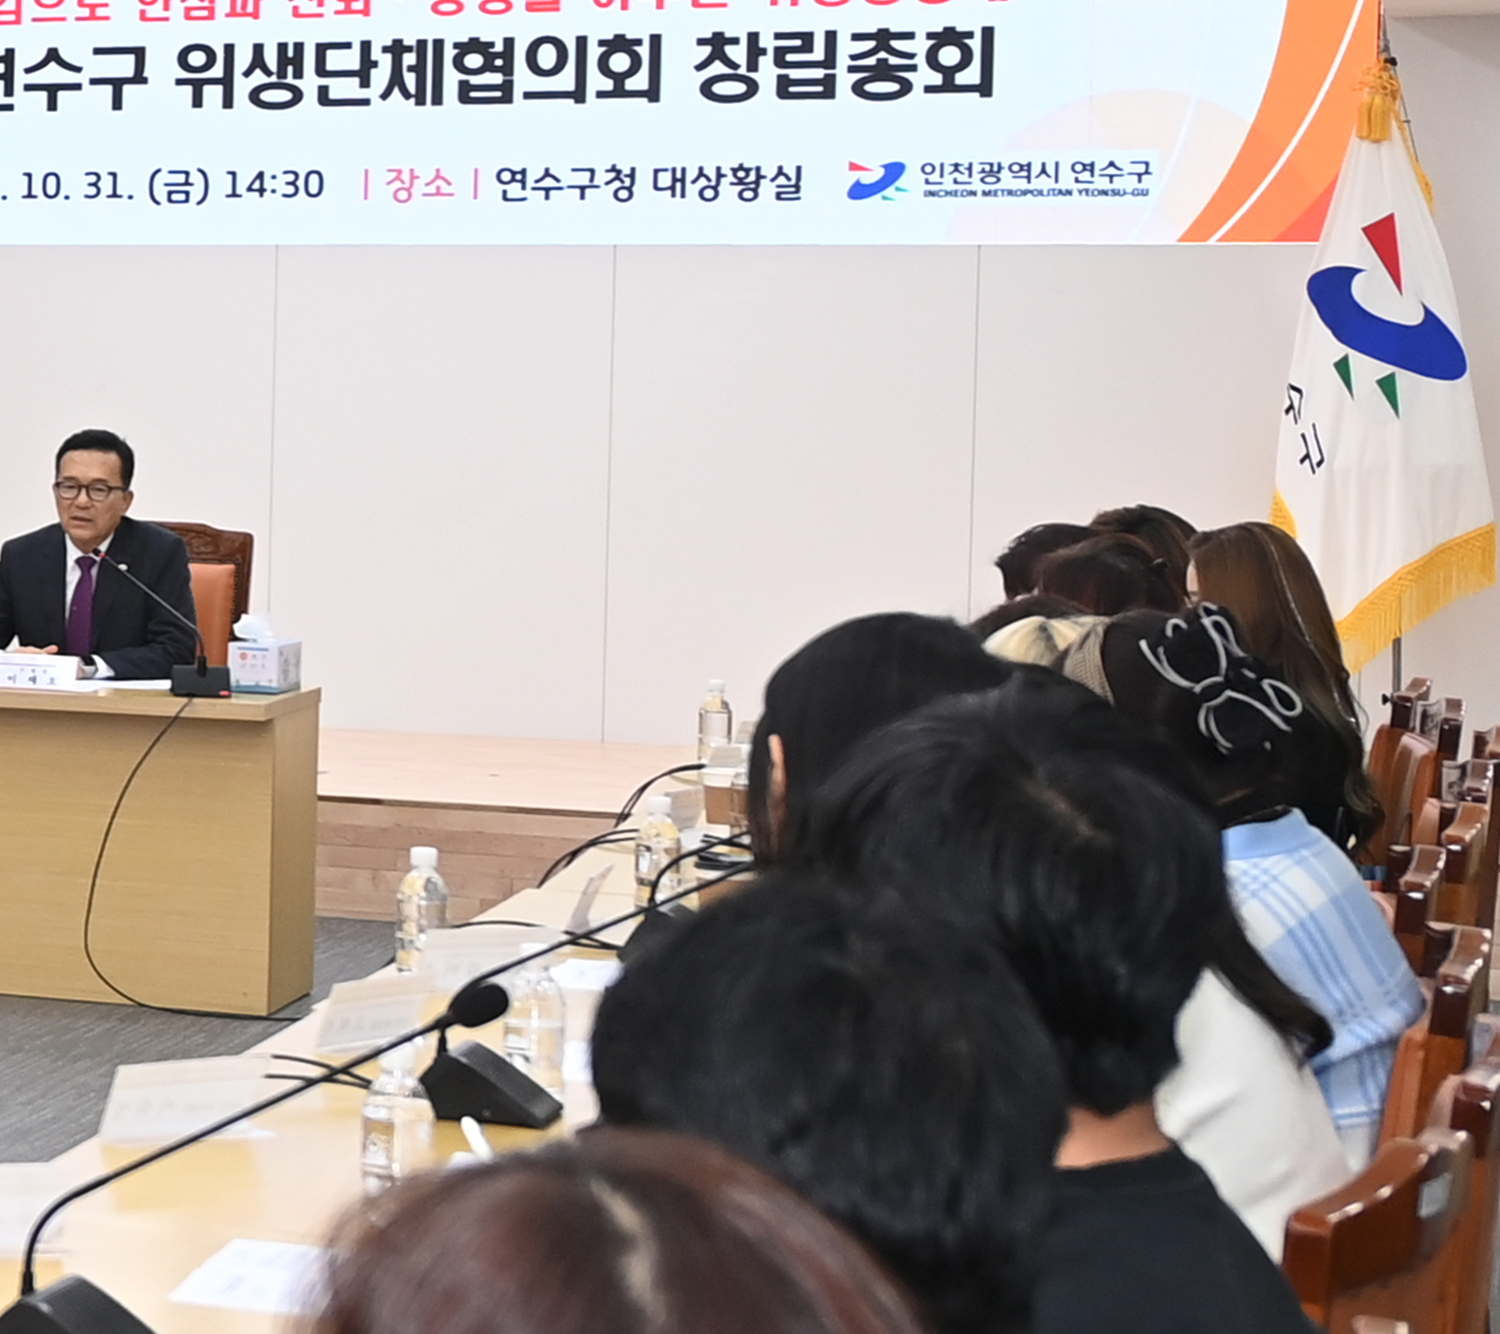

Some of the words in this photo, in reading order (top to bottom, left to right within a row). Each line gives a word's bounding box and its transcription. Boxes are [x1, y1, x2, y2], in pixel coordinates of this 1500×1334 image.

[174, 33, 662, 110] 위생단체협의회
[693, 26, 995, 104] 창립총회
[21, 172, 70, 200] 10.
[83, 171, 134, 200] 31.
[148, 167, 210, 206] (금)
[225, 170, 324, 198] 14:30
[386, 168, 455, 203] 장소
[495, 163, 636, 203] 연수구청
[652, 162, 802, 202] 대상황실
[920, 161, 1060, 185] 인천광역시
[1071, 160, 1153, 184] 연수구
[923, 189, 977, 198] INCHEON
[981, 188, 1073, 197] METROPOLITAN
[1077, 188, 1149, 197] YEONSU-GU
